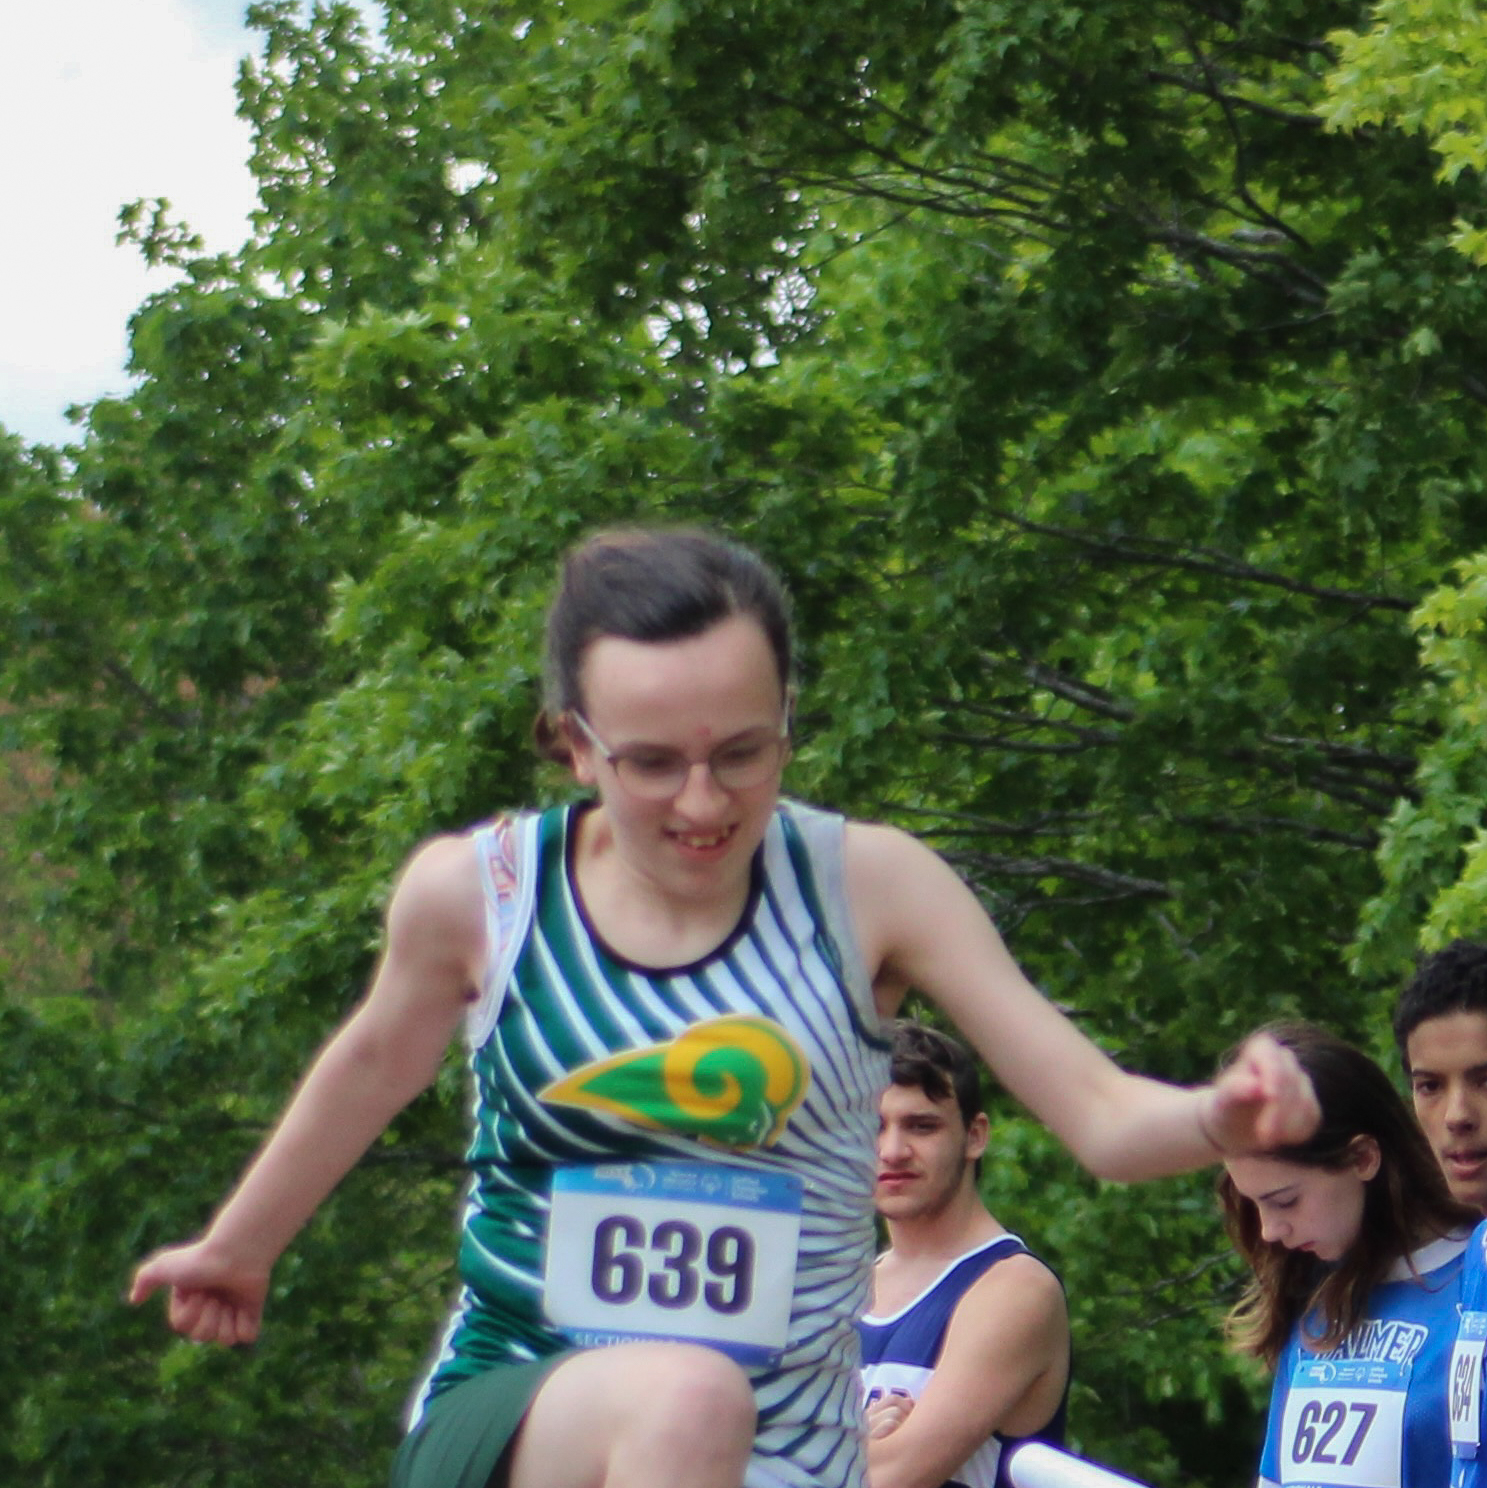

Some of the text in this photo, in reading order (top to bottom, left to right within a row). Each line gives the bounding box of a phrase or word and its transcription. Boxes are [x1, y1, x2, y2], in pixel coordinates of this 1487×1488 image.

[591, 1214, 756, 1316] 639
[1317, 1319, 1429, 1367] ALMER
[1292, 1400, 1378, 1466] 627
